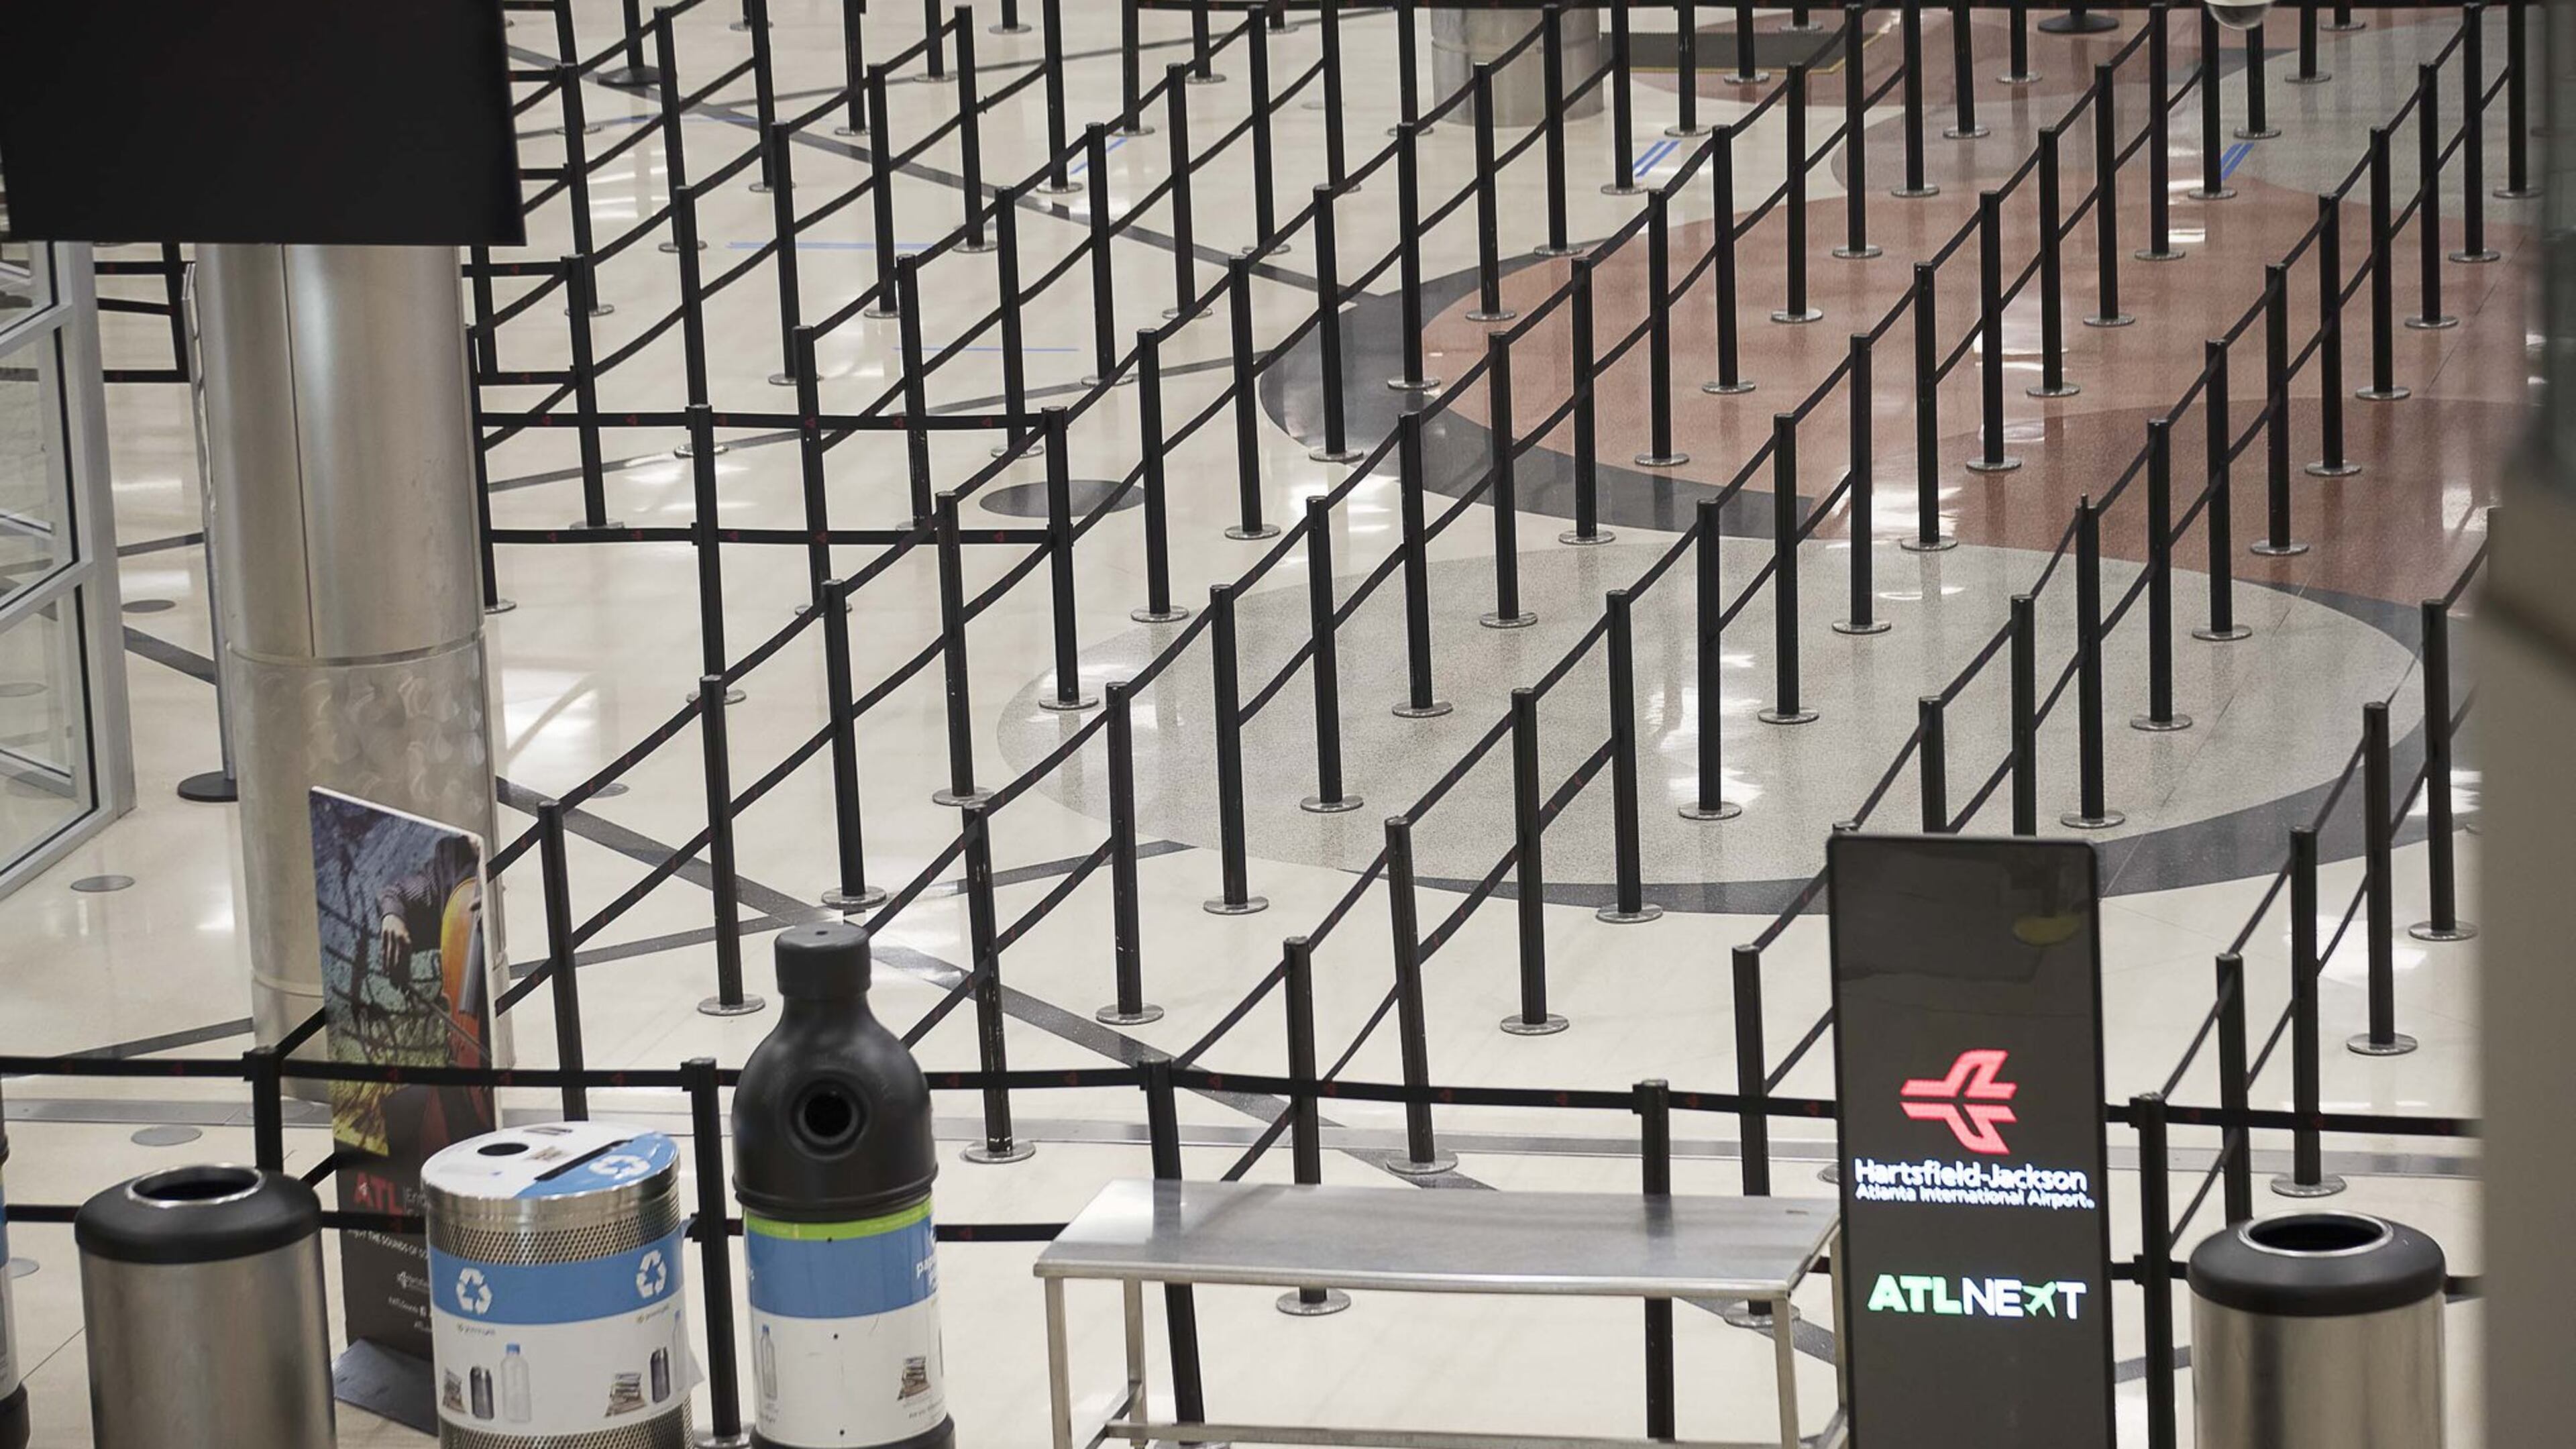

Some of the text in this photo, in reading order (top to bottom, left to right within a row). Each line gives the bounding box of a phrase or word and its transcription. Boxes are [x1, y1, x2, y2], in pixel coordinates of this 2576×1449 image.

[1854, 1159, 2087, 1191] Hartsfield-Jackson
[1856, 1183, 1917, 1201] Atlanta
[1919, 1184, 2025, 1205] International
